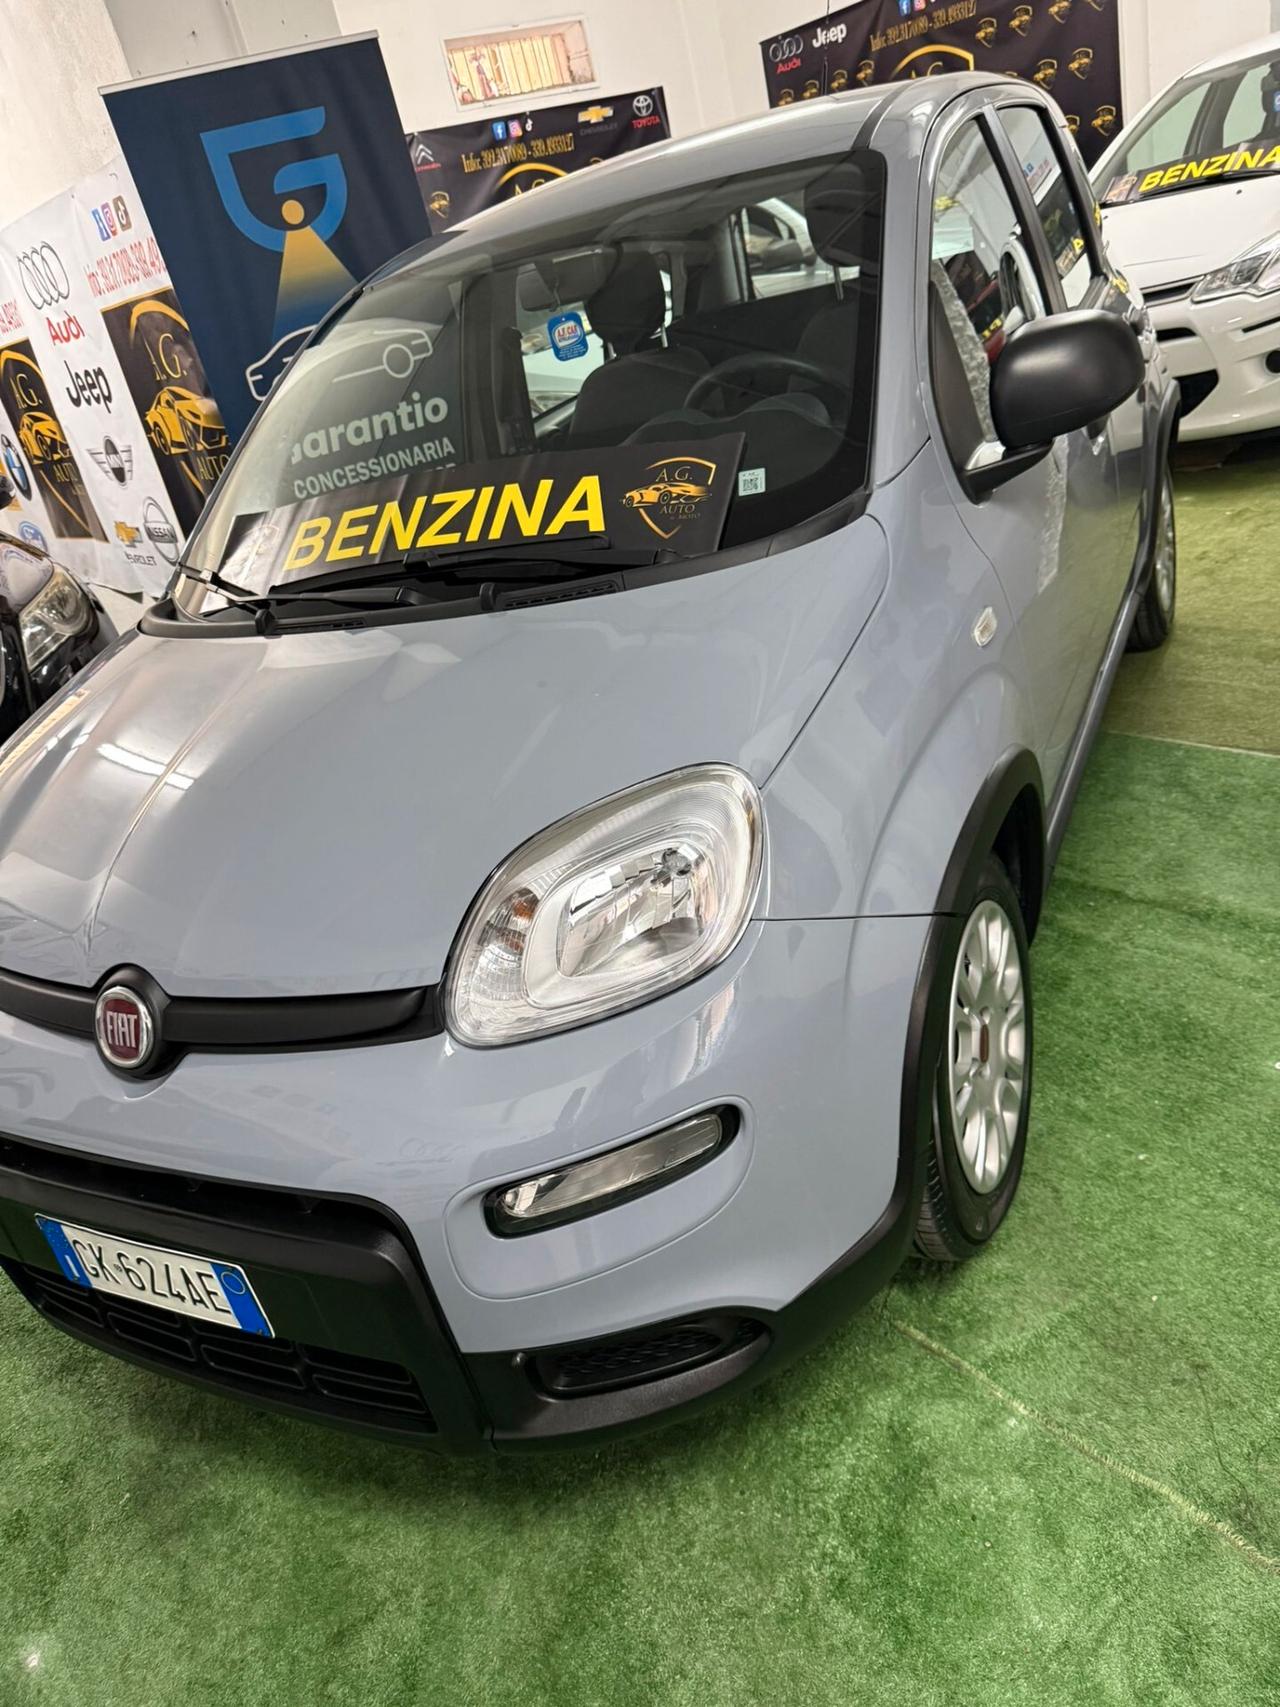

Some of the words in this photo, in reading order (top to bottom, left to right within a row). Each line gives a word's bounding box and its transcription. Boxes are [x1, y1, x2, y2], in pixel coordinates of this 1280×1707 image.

[812, 23, 847, 48] Jeep
[776, 58, 801, 74] Audi
[632, 114, 661, 129] TOYOTA
[1138, 144, 1280, 193] BENZINA
[46, 309, 86, 346] Audi
[63, 359, 112, 414] Jeep
[294, 436, 456, 500] CONCESSIONARIA
[655, 465, 694, 483] A.G.
[282, 474, 606, 573] BENZINA
[660, 503, 696, 515] AUTO
[106, 1011, 138, 1049] FIAT
